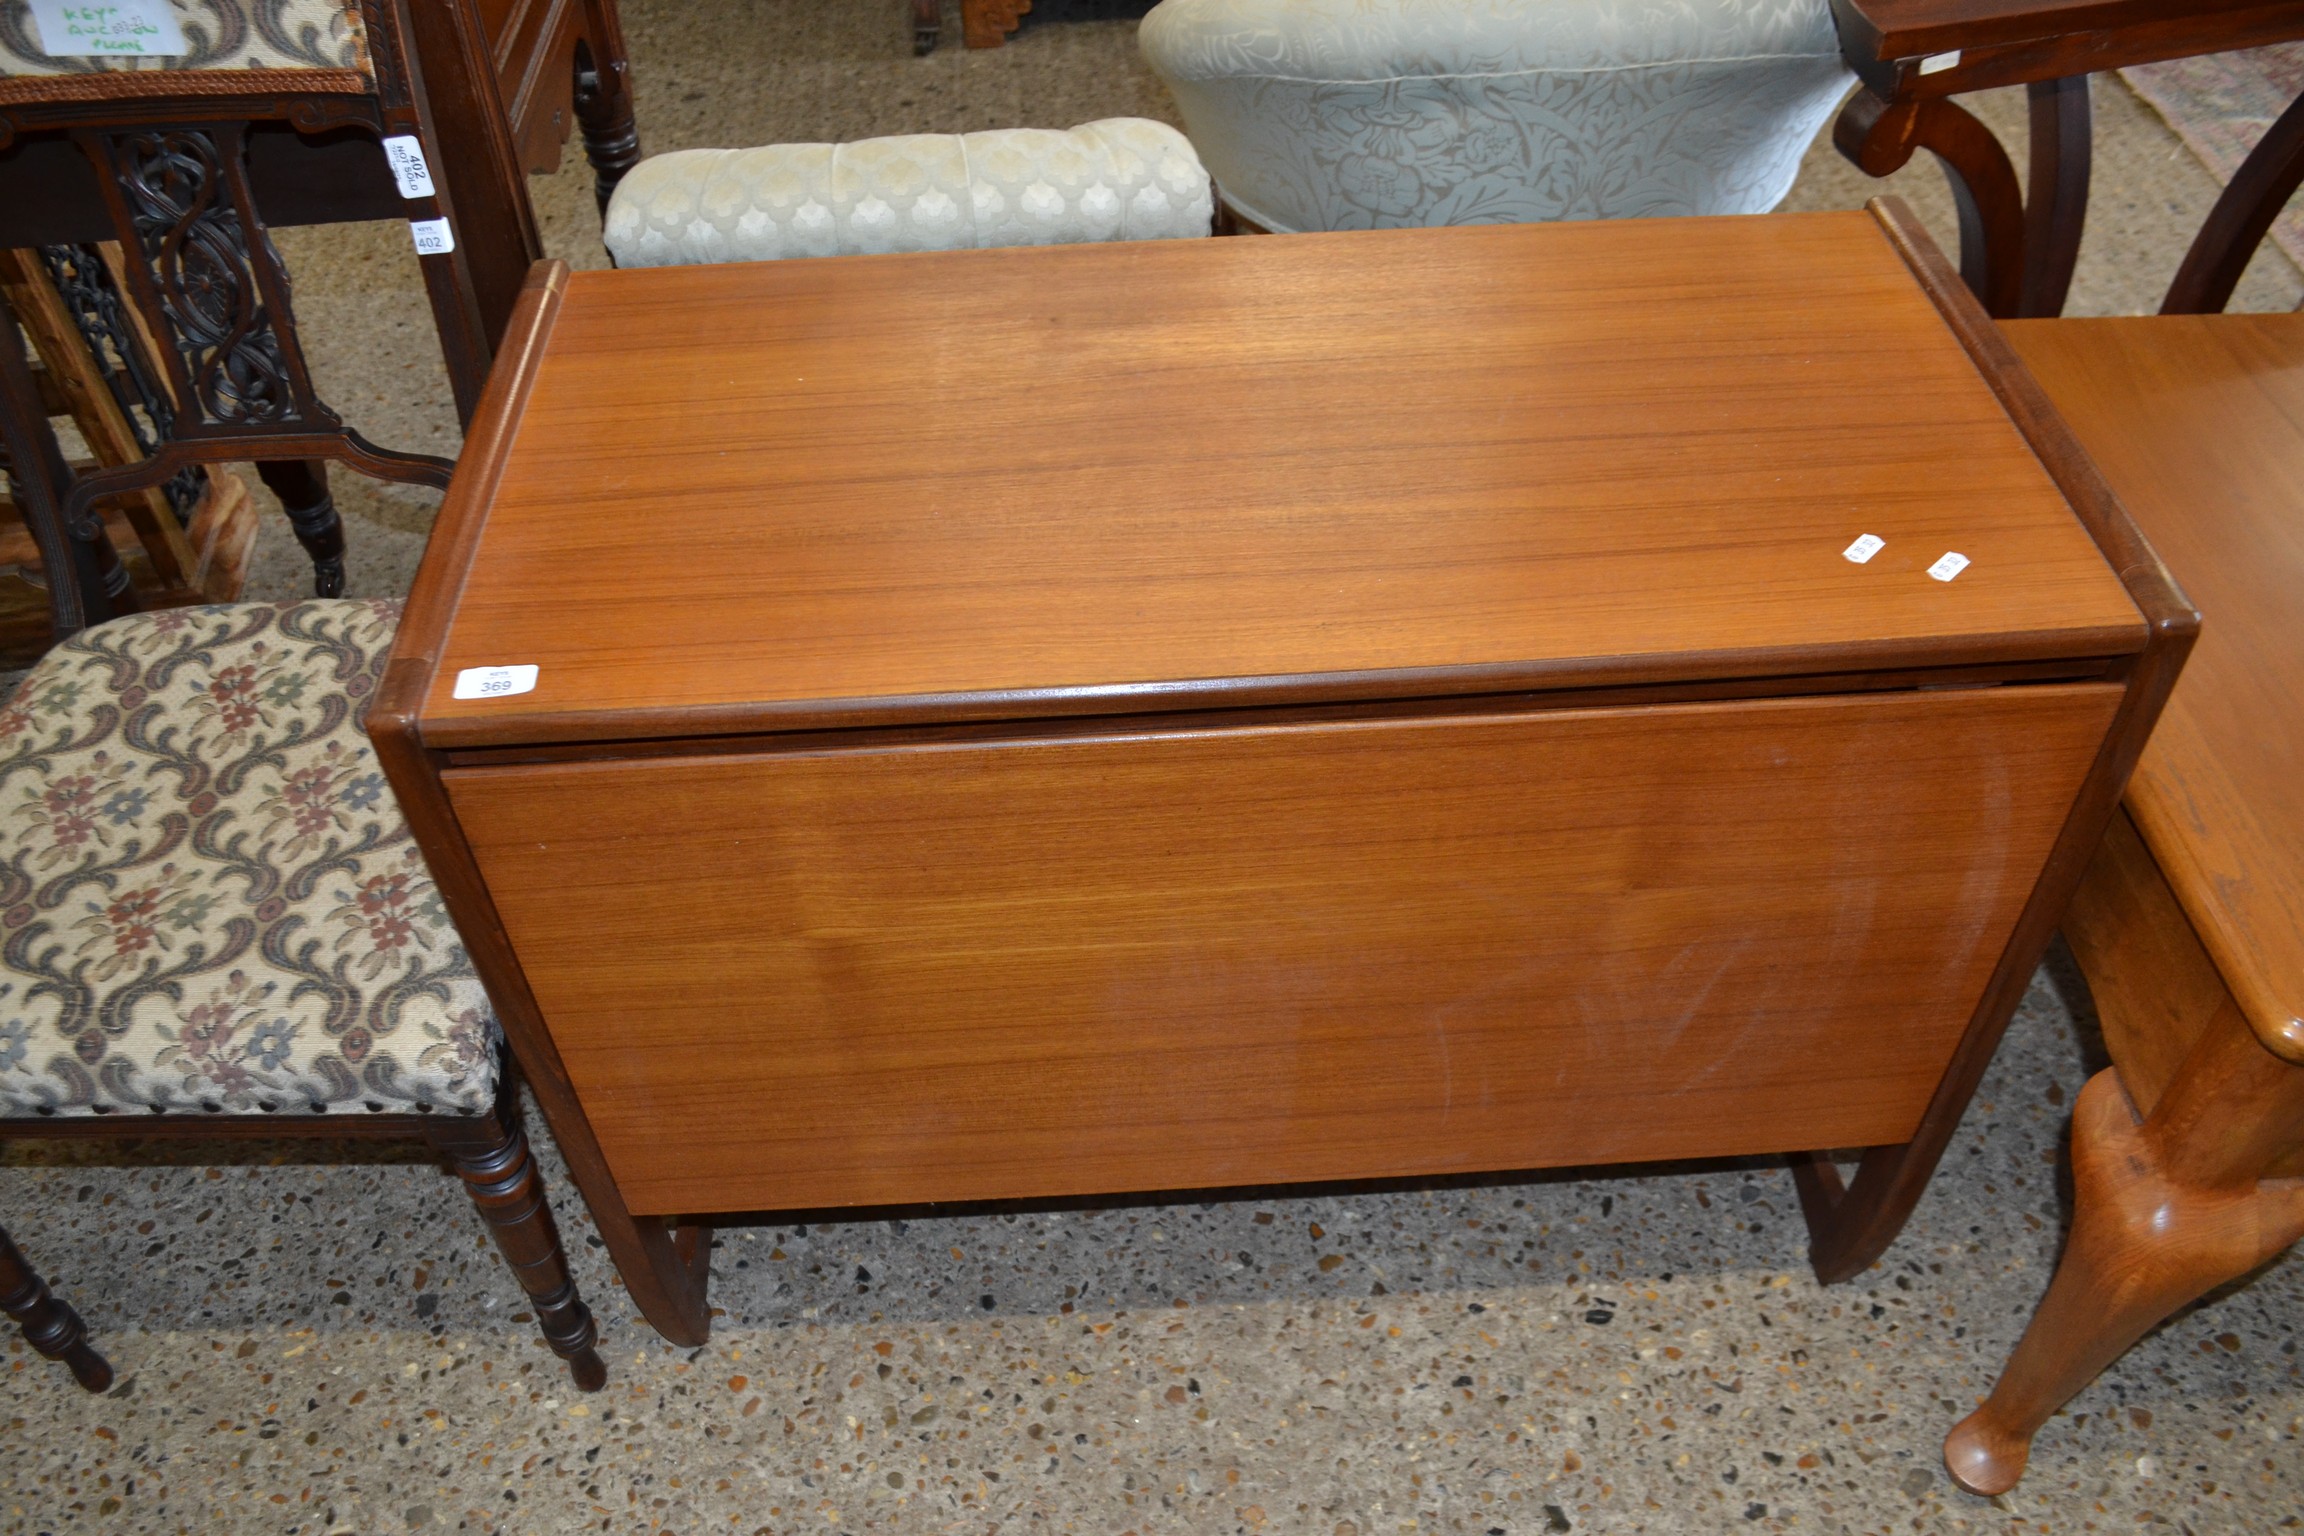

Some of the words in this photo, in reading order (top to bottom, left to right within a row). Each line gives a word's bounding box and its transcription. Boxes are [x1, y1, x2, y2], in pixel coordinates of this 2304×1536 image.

[68, 24, 159, 36] AUCON
[397, 145, 410, 165] NOT
[404, 167, 419, 192] SOLD
[409, 154, 427, 179] 402
[418, 236, 442, 248] 402
[480, 680, 512, 692] 369
